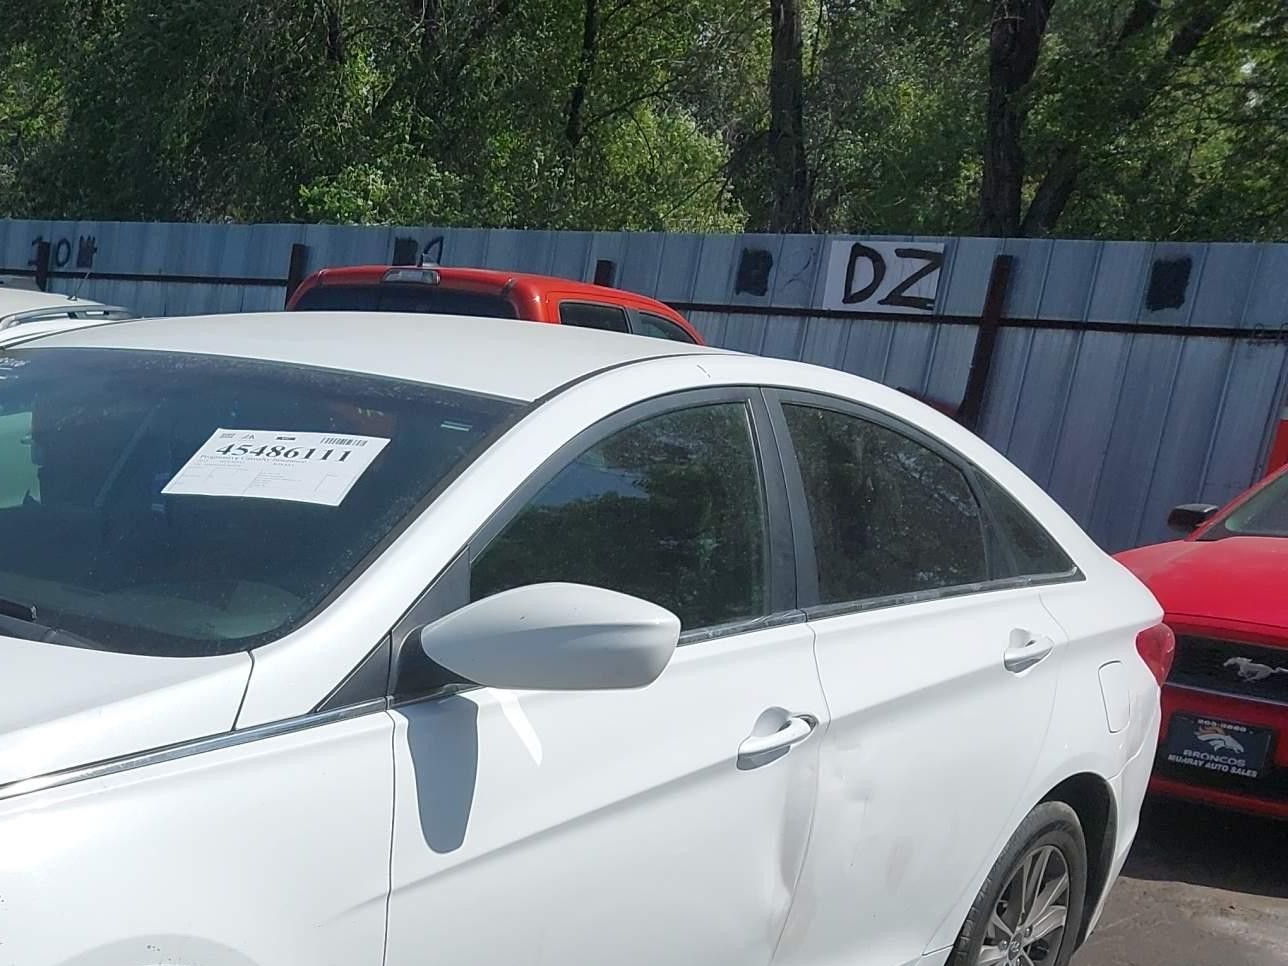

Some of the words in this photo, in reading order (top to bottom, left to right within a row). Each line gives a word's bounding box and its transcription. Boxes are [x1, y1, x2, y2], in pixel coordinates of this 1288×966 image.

[842, 242, 943, 311] DZ
[215, 443, 353, 463] 45486111
[1183, 749, 1247, 767] BRONCOS
[1205, 762, 1229, 772] AUTO
[1230, 766, 1258, 778] SALES
